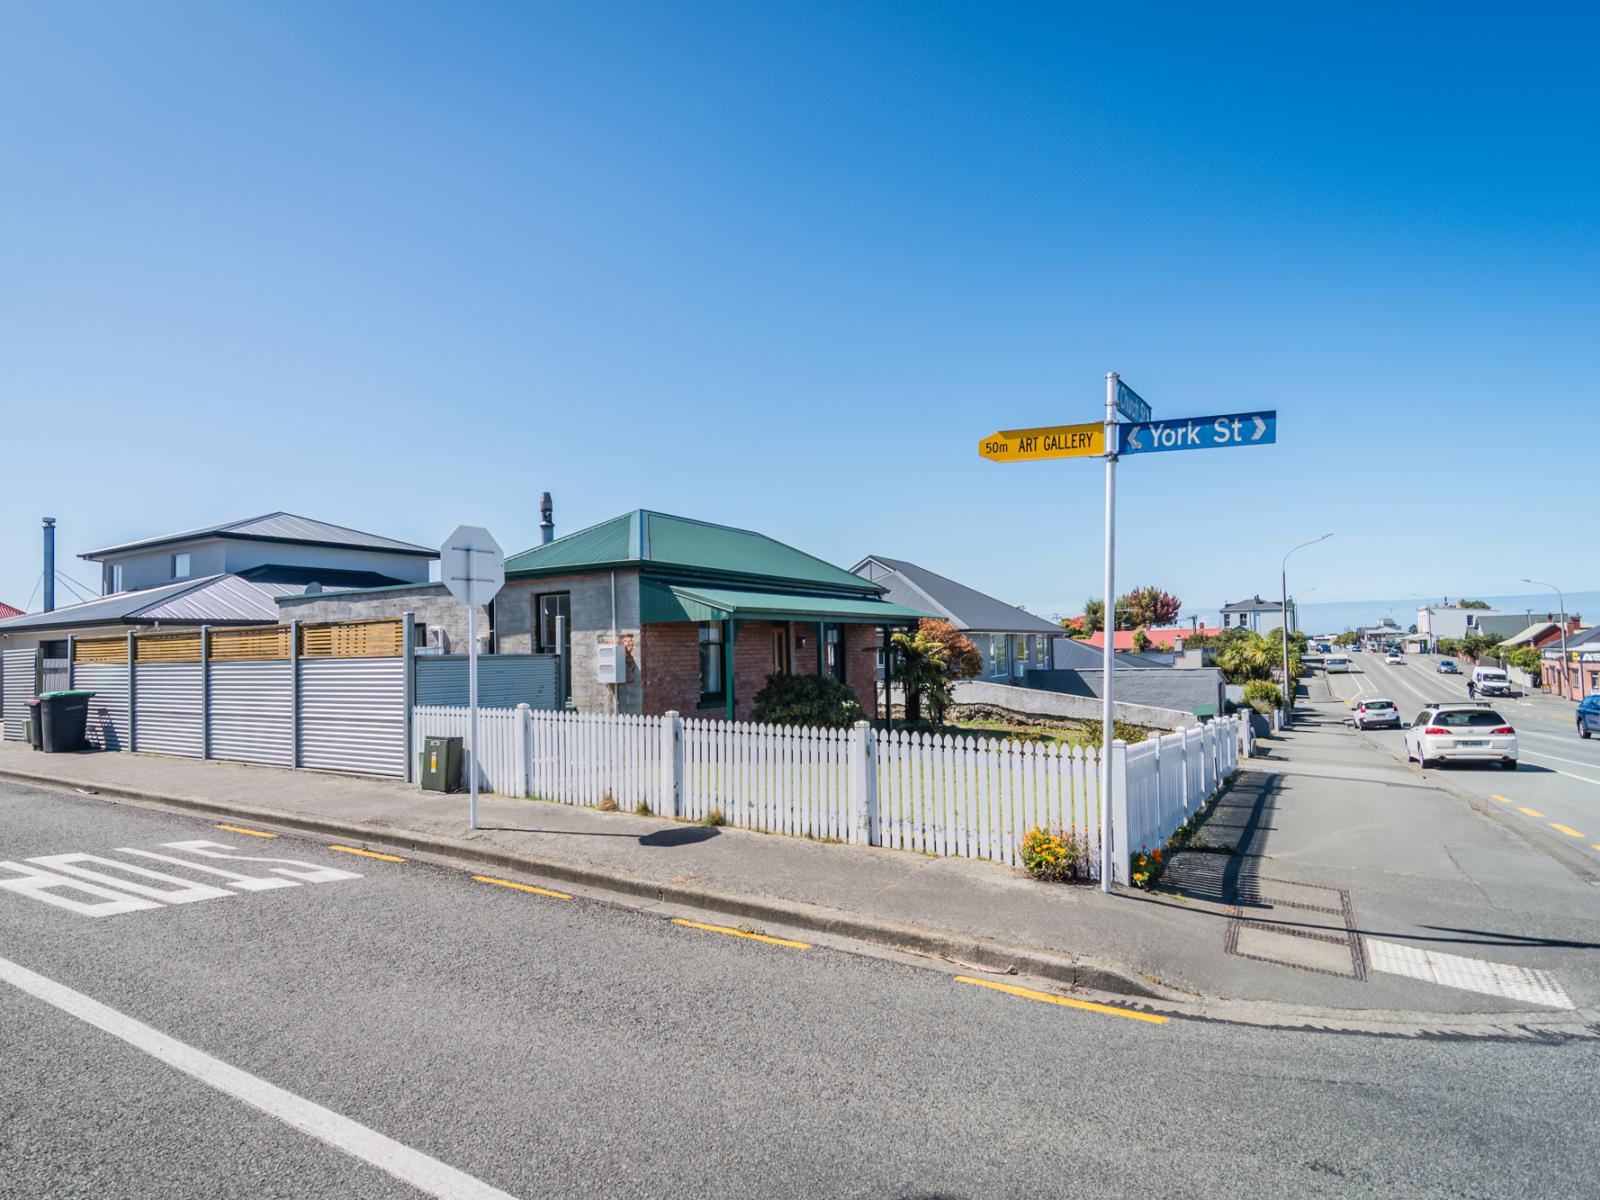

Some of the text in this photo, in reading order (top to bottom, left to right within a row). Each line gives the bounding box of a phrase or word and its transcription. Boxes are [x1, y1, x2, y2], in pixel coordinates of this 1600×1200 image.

[985, 432, 1094, 454] 50m ART GALLERY
[1149, 417, 1242, 447] York St
[0, 840, 365, 918] STOP
